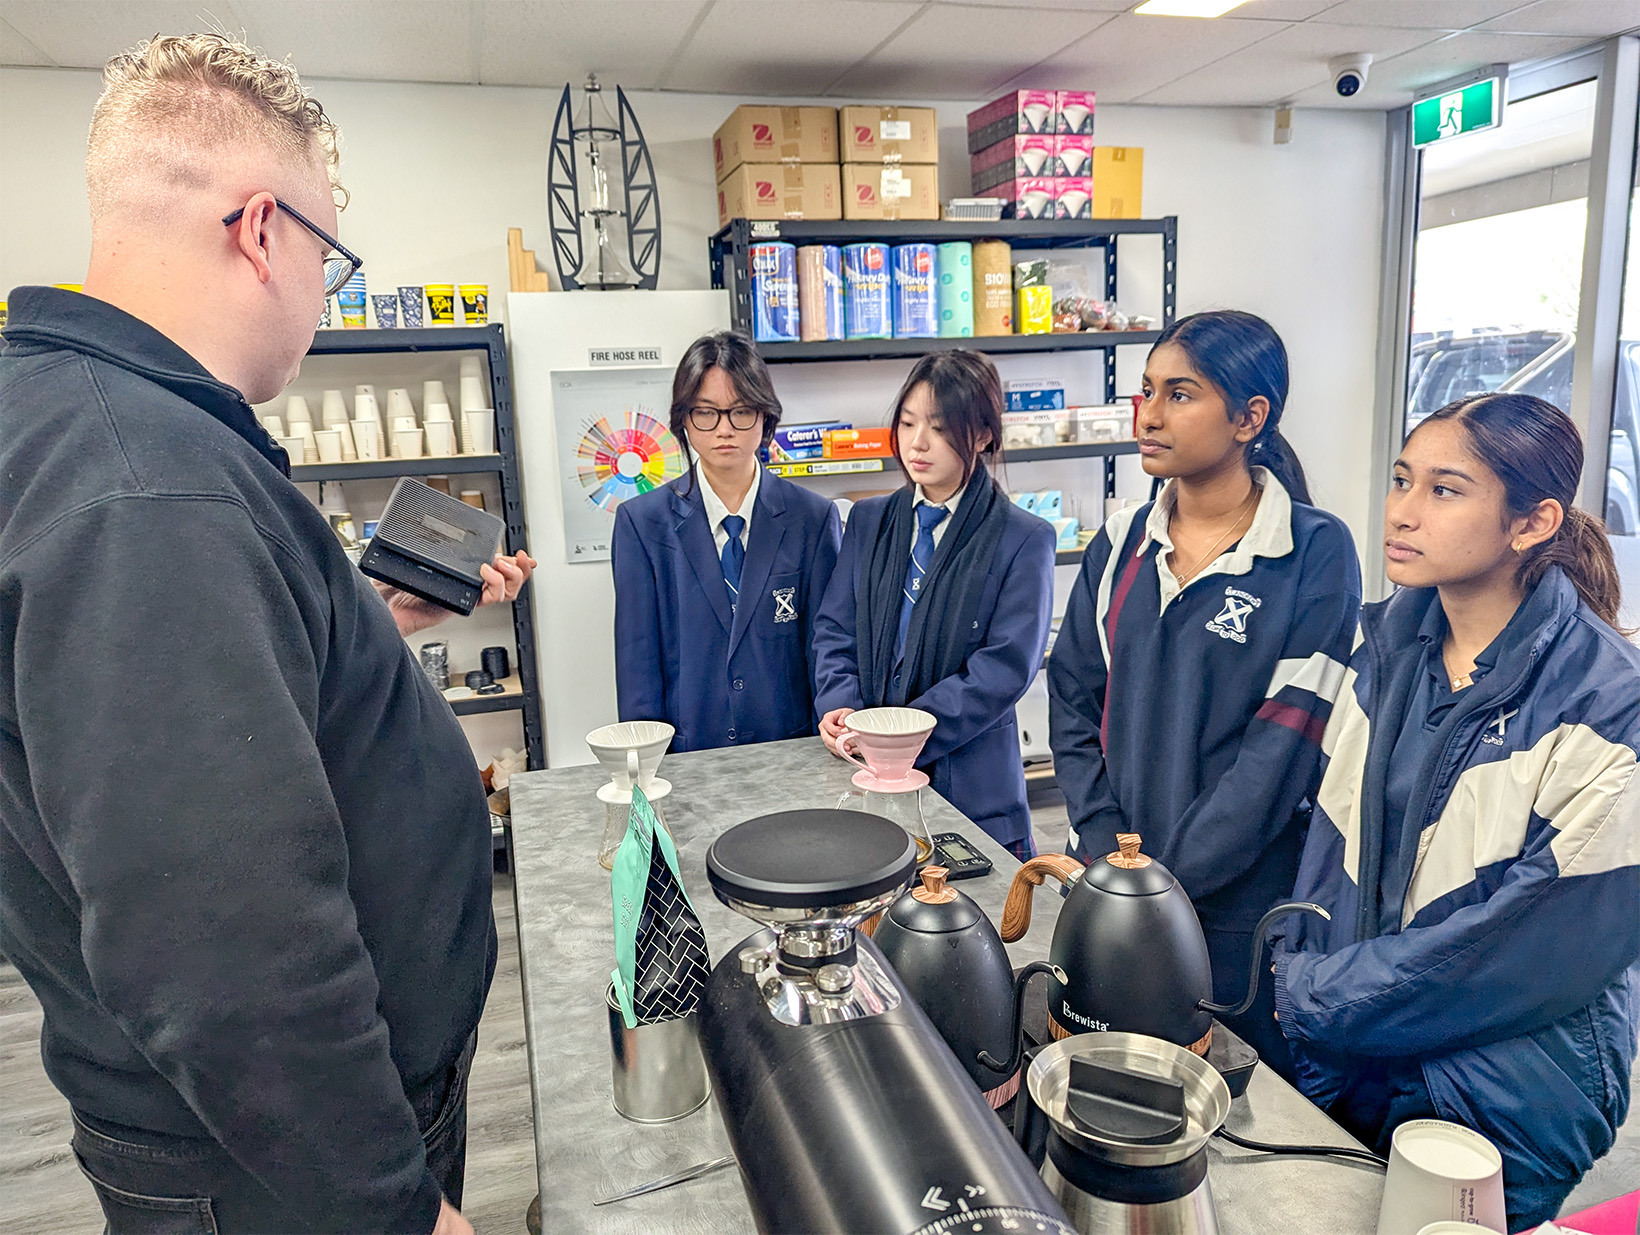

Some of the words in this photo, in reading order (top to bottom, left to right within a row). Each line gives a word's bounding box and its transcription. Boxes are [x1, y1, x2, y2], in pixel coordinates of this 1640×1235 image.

[591, 351, 610, 361] FIRE
[613, 351, 635, 361] HOSE
[638, 350, 659, 360] REEL
[1012, 393, 1020, 401] M
[787, 428, 818, 441] Caterer's
[854, 442, 869, 450] Baking
[1063, 1000, 1107, 1032] Brewista
